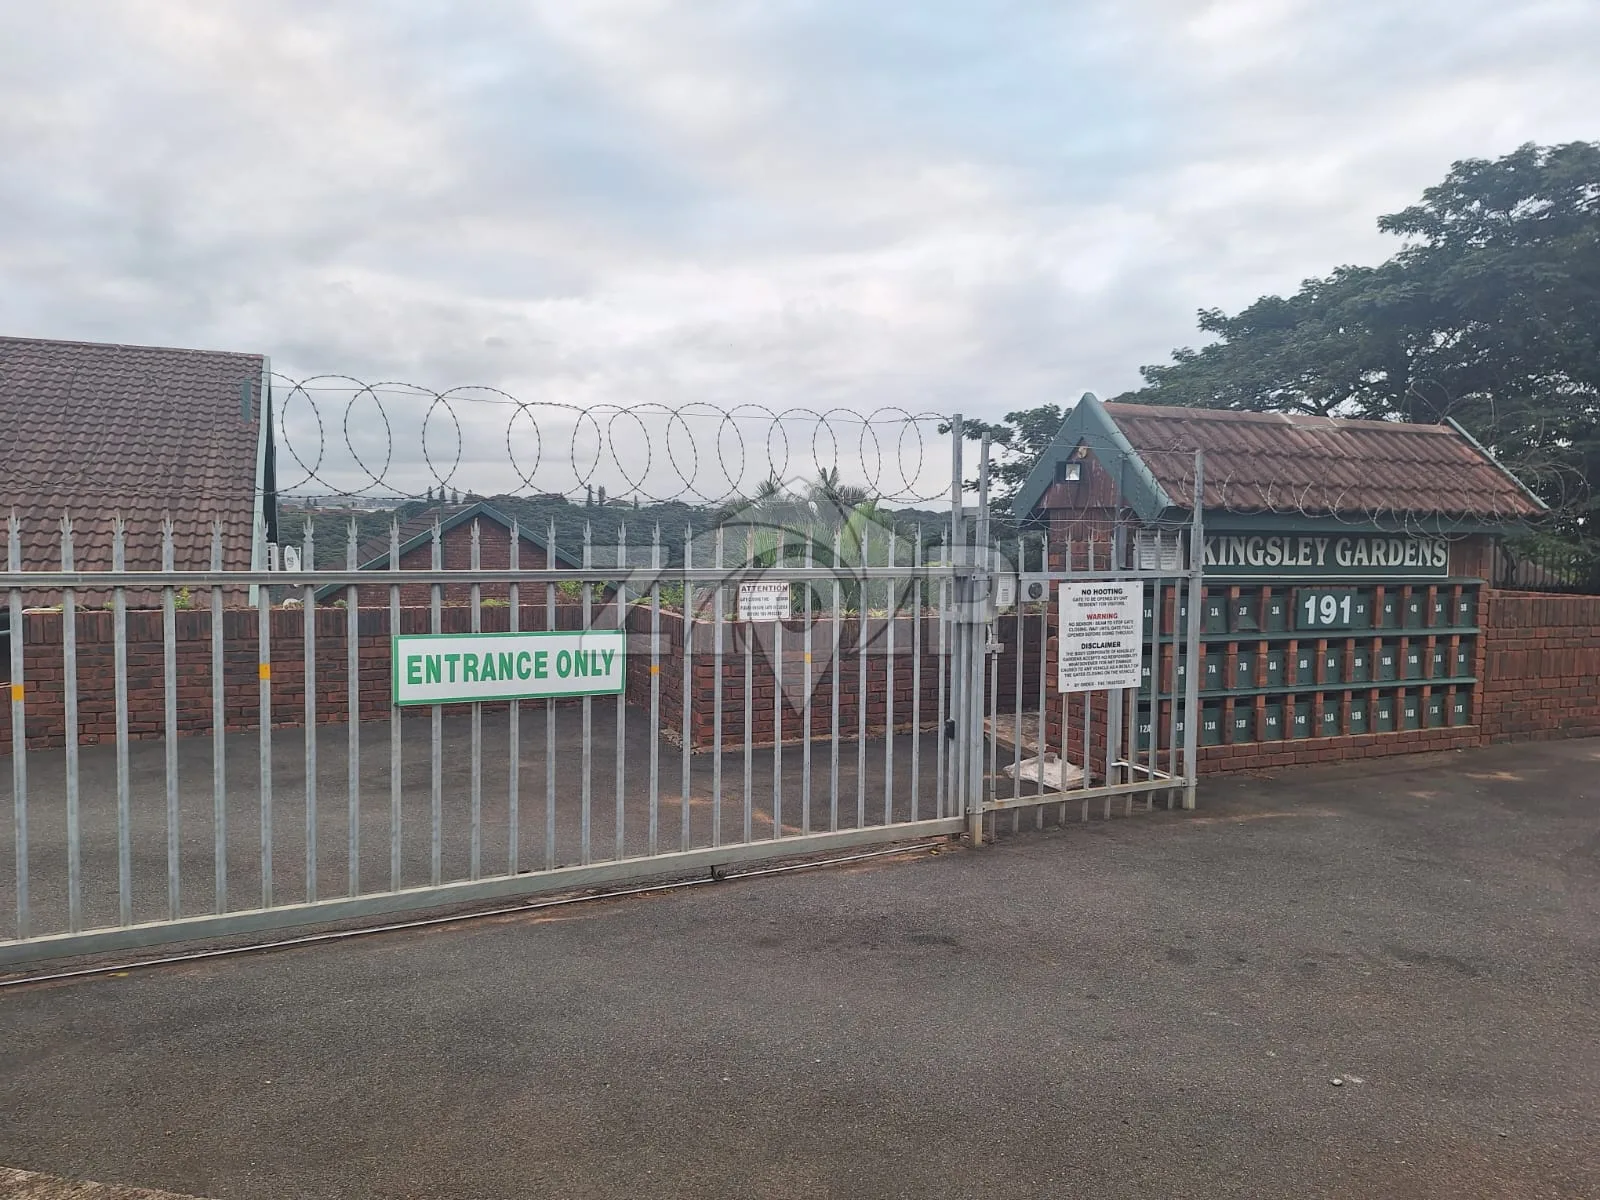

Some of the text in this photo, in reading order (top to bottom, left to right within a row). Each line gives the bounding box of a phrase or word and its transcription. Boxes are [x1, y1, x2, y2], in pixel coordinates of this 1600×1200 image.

[1202, 536, 1330, 567] KINGSLEY
[1336, 537, 1447, 567] GARDENS
[1082, 588, 1092, 596] NO
[1144, 609, 1152, 618] 1A
[1305, 595, 1351, 624] 191
[1087, 612, 1118, 620] WARNING
[1081, 641, 1121, 650] DISCLAIMER
[407, 649, 615, 685] ENTRANCE ONLY
[1208, 665, 1216, 674] 7A
[1204, 721, 1216, 730] 13A
